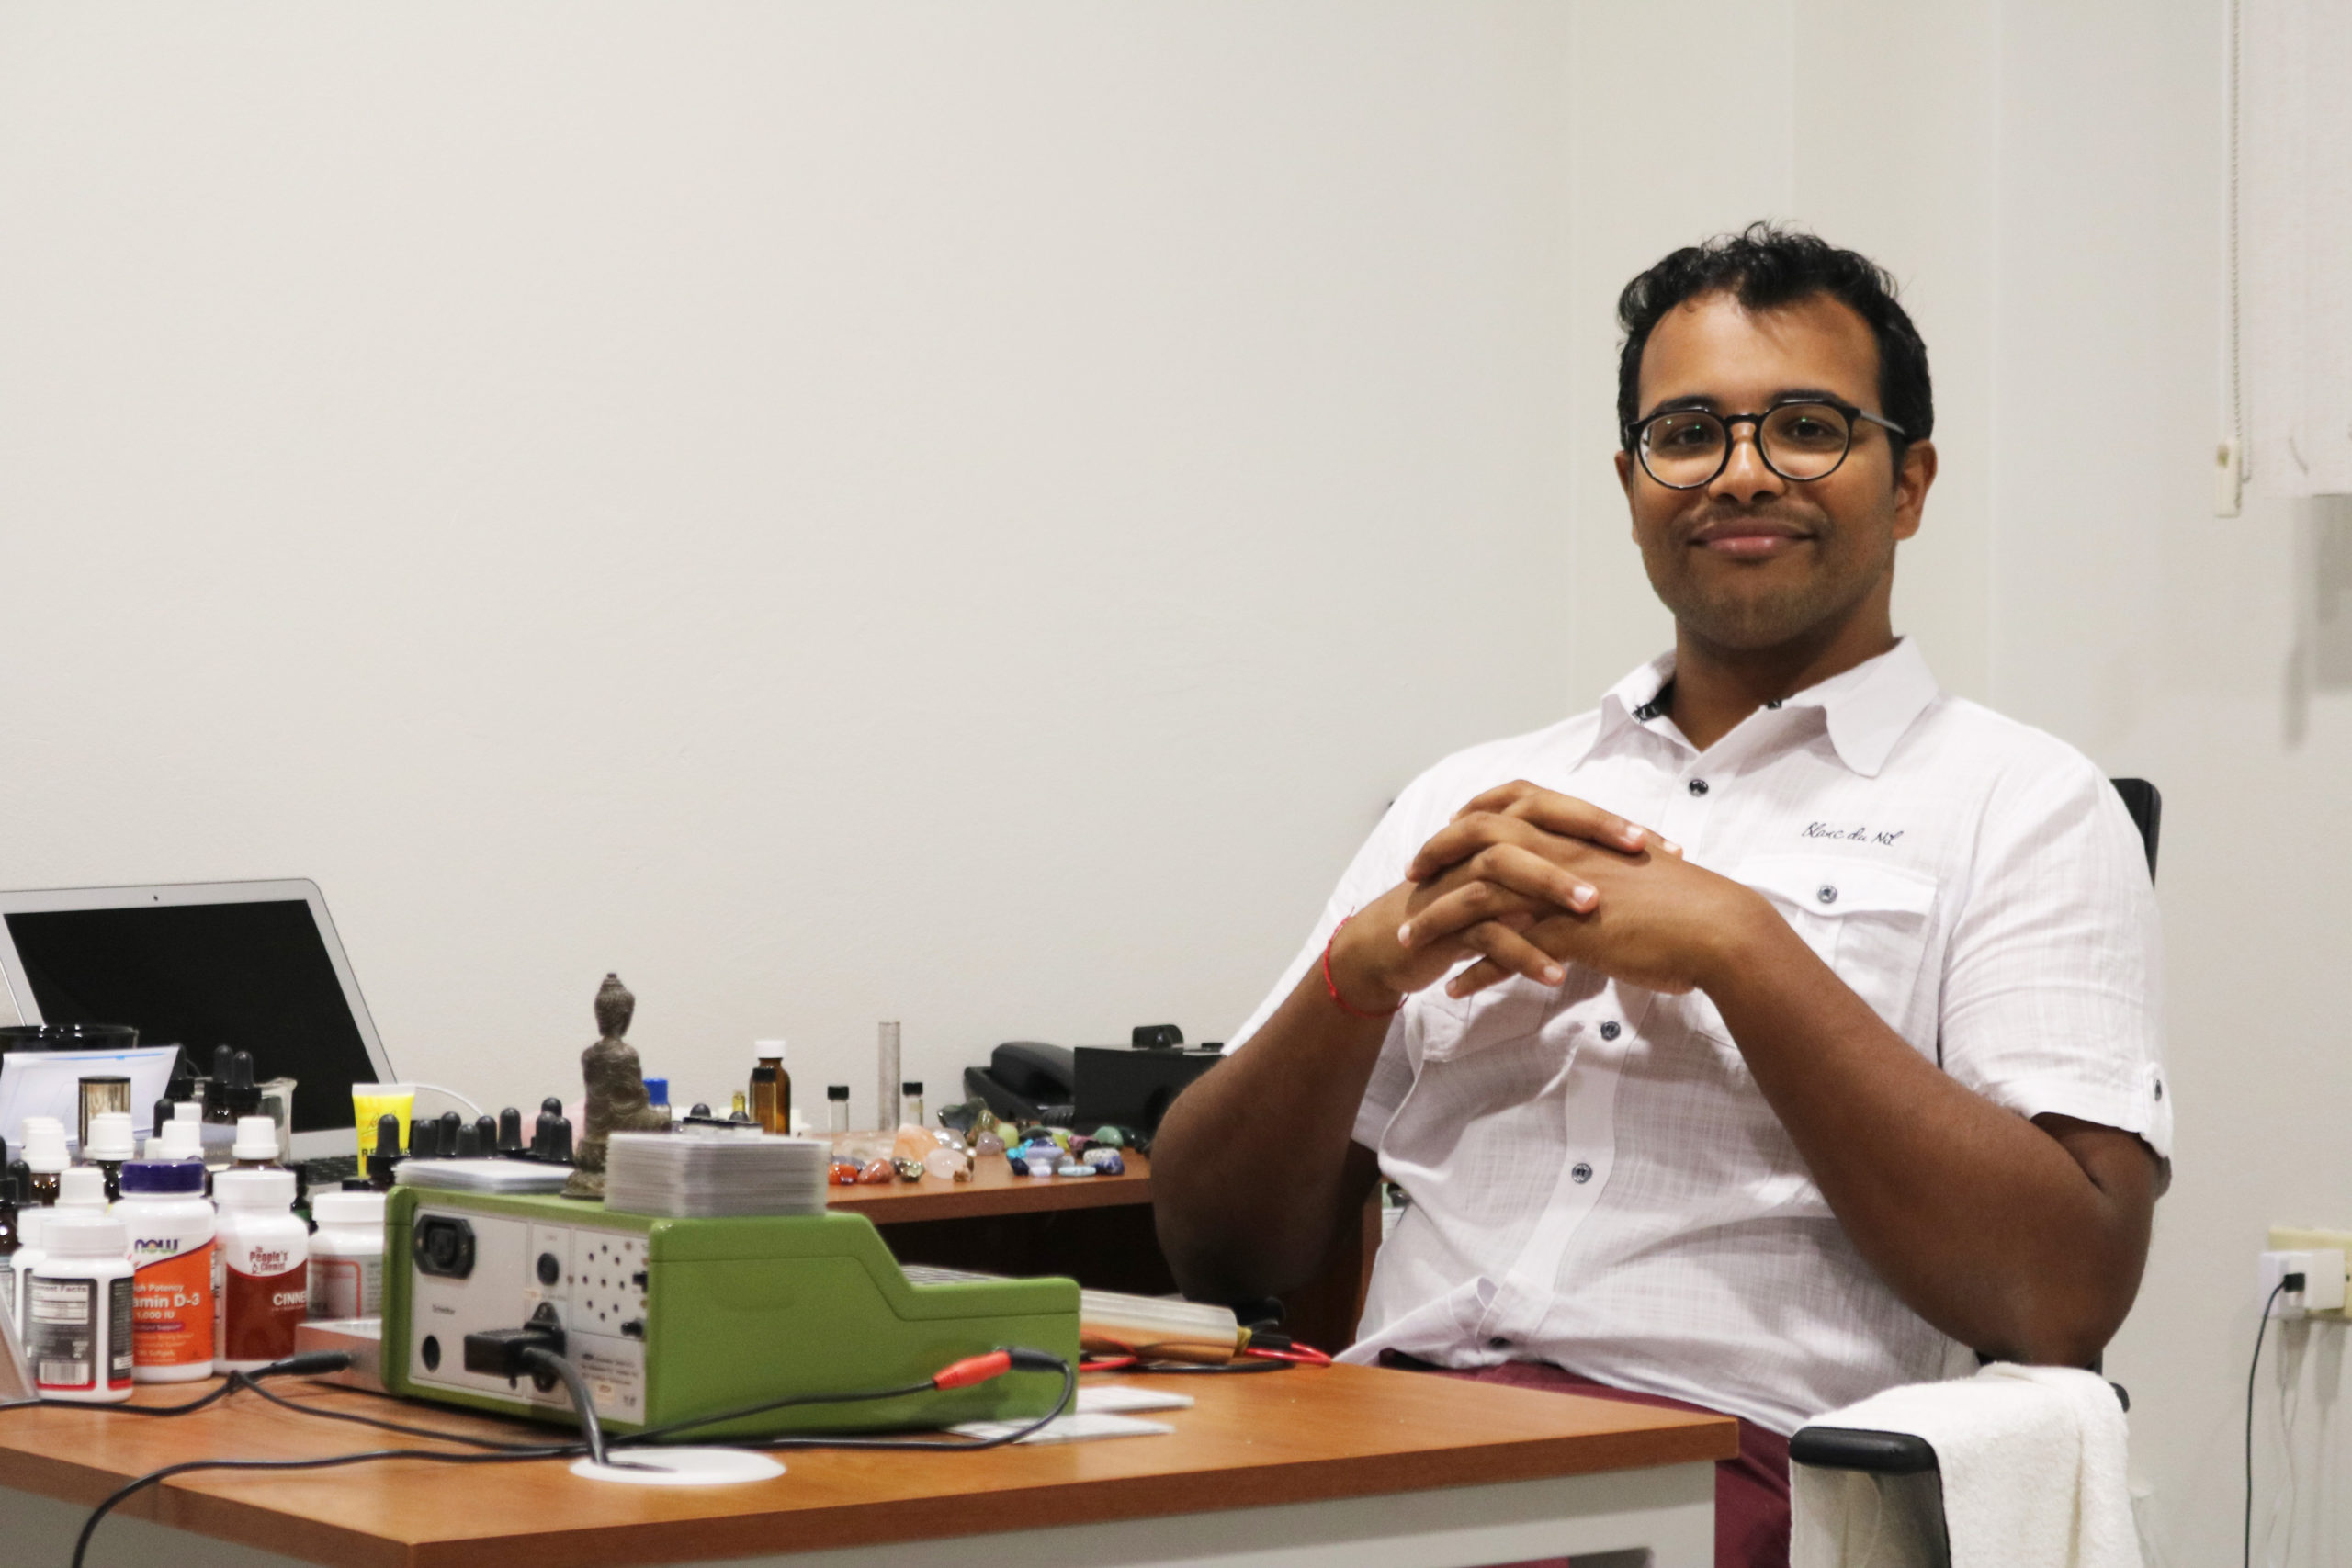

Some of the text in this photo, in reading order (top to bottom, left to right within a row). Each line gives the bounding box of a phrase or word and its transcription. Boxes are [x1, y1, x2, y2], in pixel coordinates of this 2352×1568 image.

[249, 1251, 288, 1263] People's
[148, 1284, 184, 1293] Potency
[132, 1293, 199, 1308] amin D-3
[164, 1311, 175, 1319] IU
